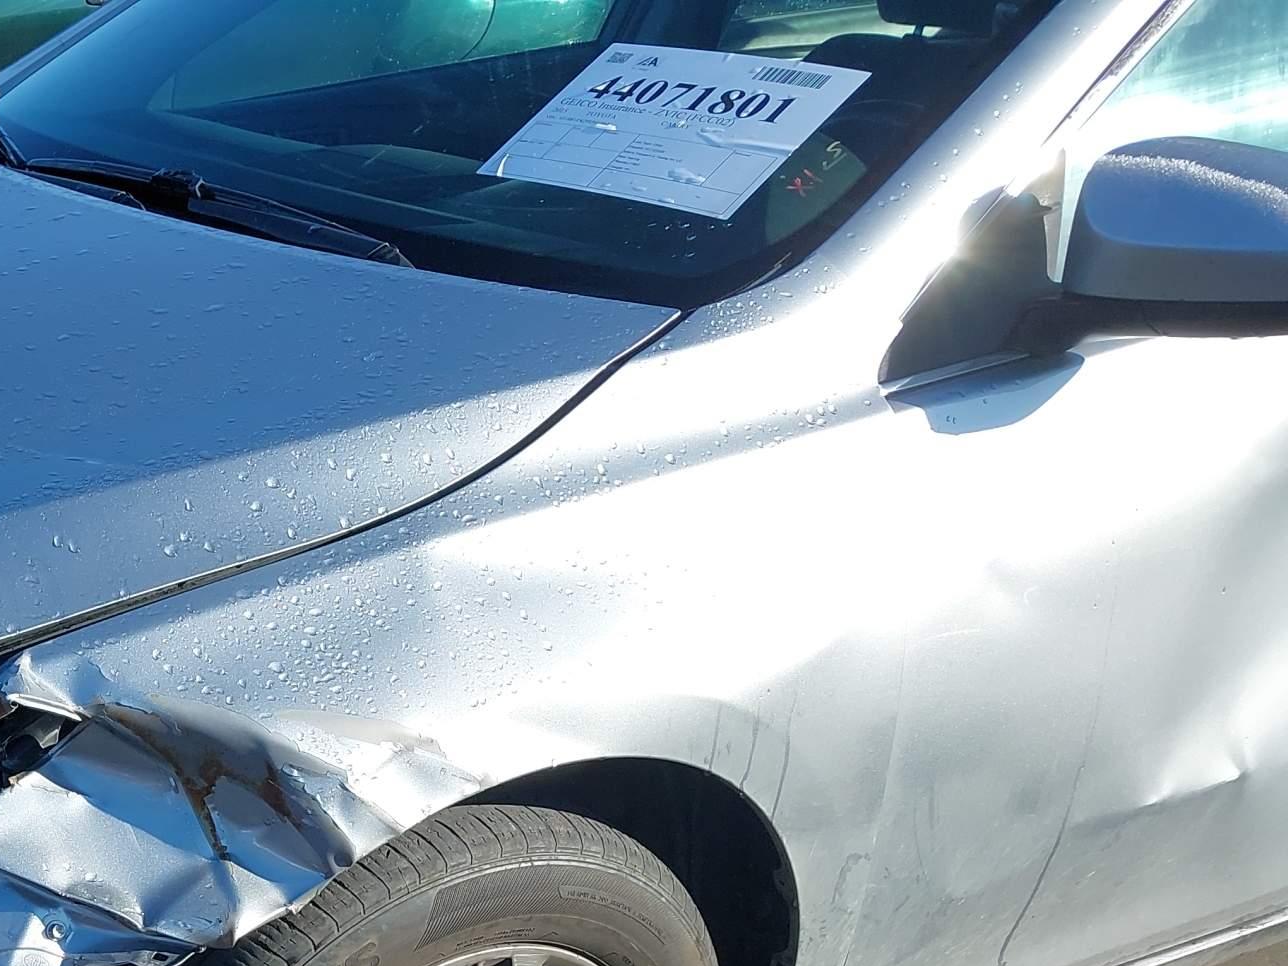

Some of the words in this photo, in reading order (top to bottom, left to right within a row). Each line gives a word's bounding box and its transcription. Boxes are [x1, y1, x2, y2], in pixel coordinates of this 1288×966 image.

[560, 97, 598, 108] GEICO
[597, 102, 647, 115] Insurance
[587, 75, 798, 124] 44071801
